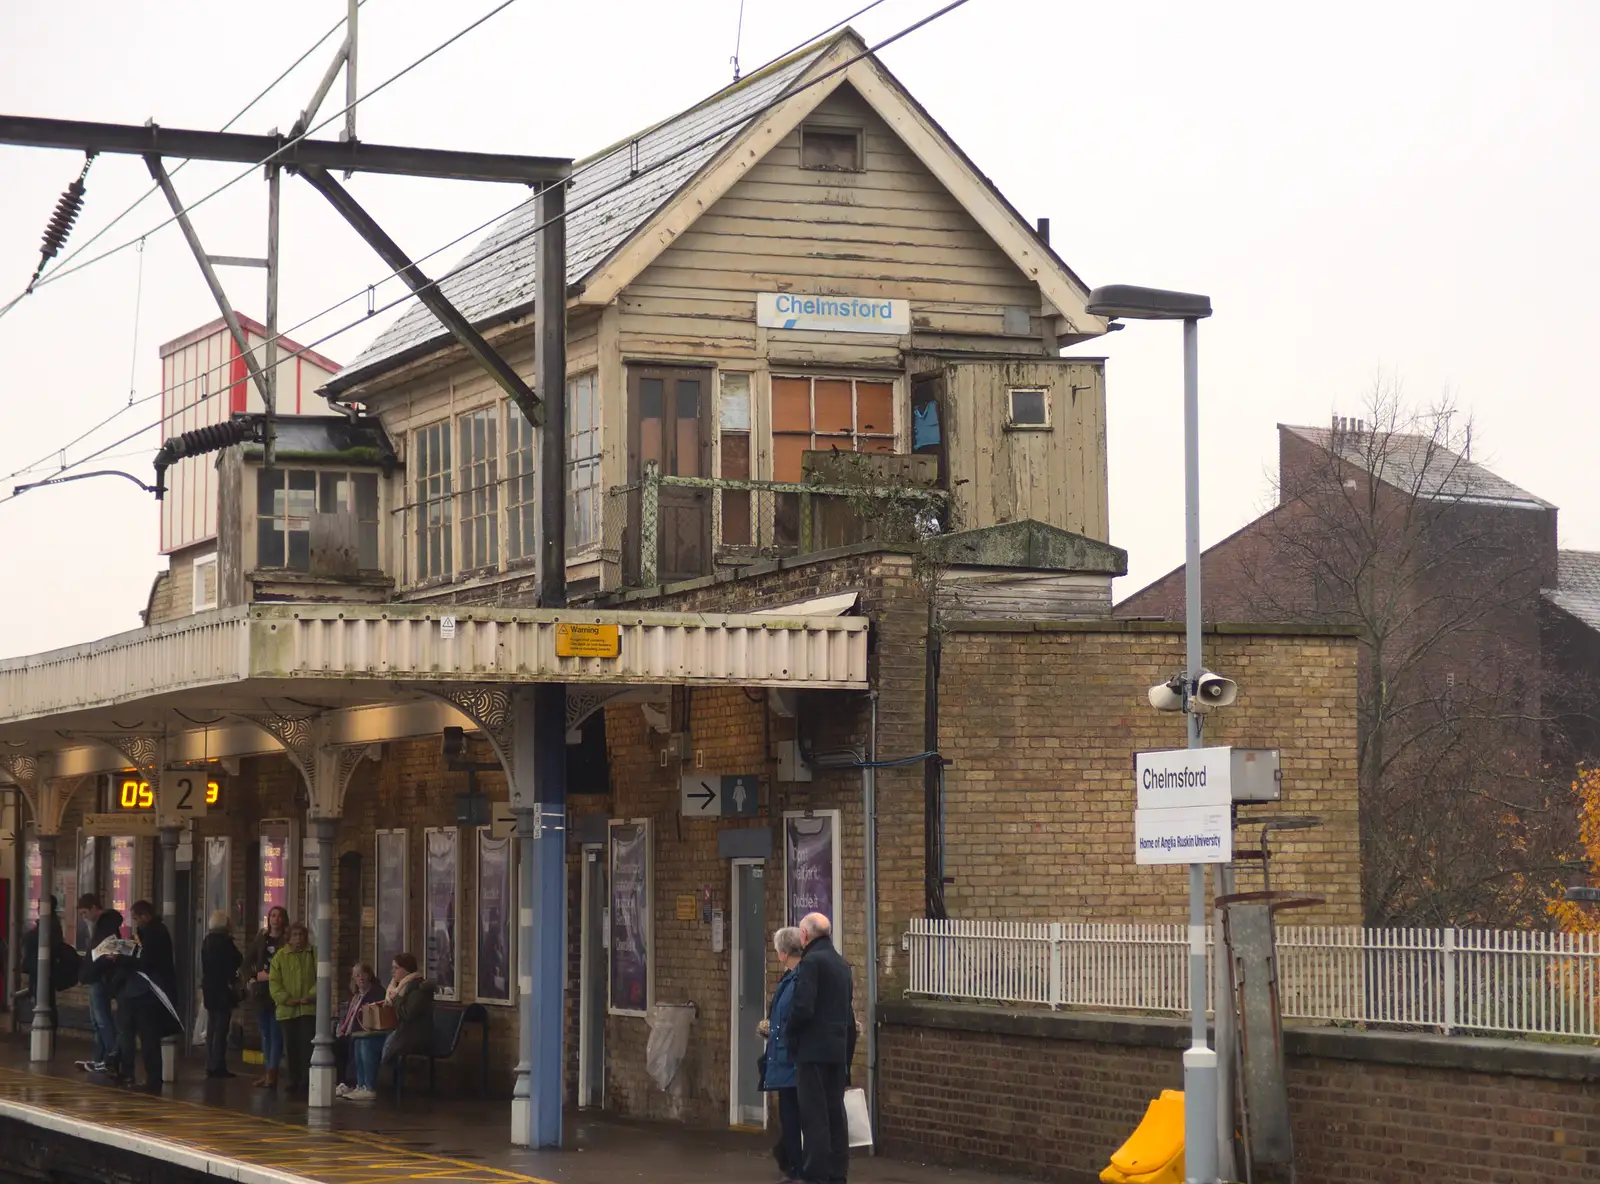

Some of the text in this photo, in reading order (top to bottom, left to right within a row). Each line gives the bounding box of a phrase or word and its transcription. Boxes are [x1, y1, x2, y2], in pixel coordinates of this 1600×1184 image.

[776, 295, 892, 319] Chelmsford
[570, 625, 599, 635] Warning
[1143, 765, 1206, 790] Chelmsford
[177, 778, 193, 809] 2
[1139, 833, 1221, 852] Home of Anglia Ruskin University
